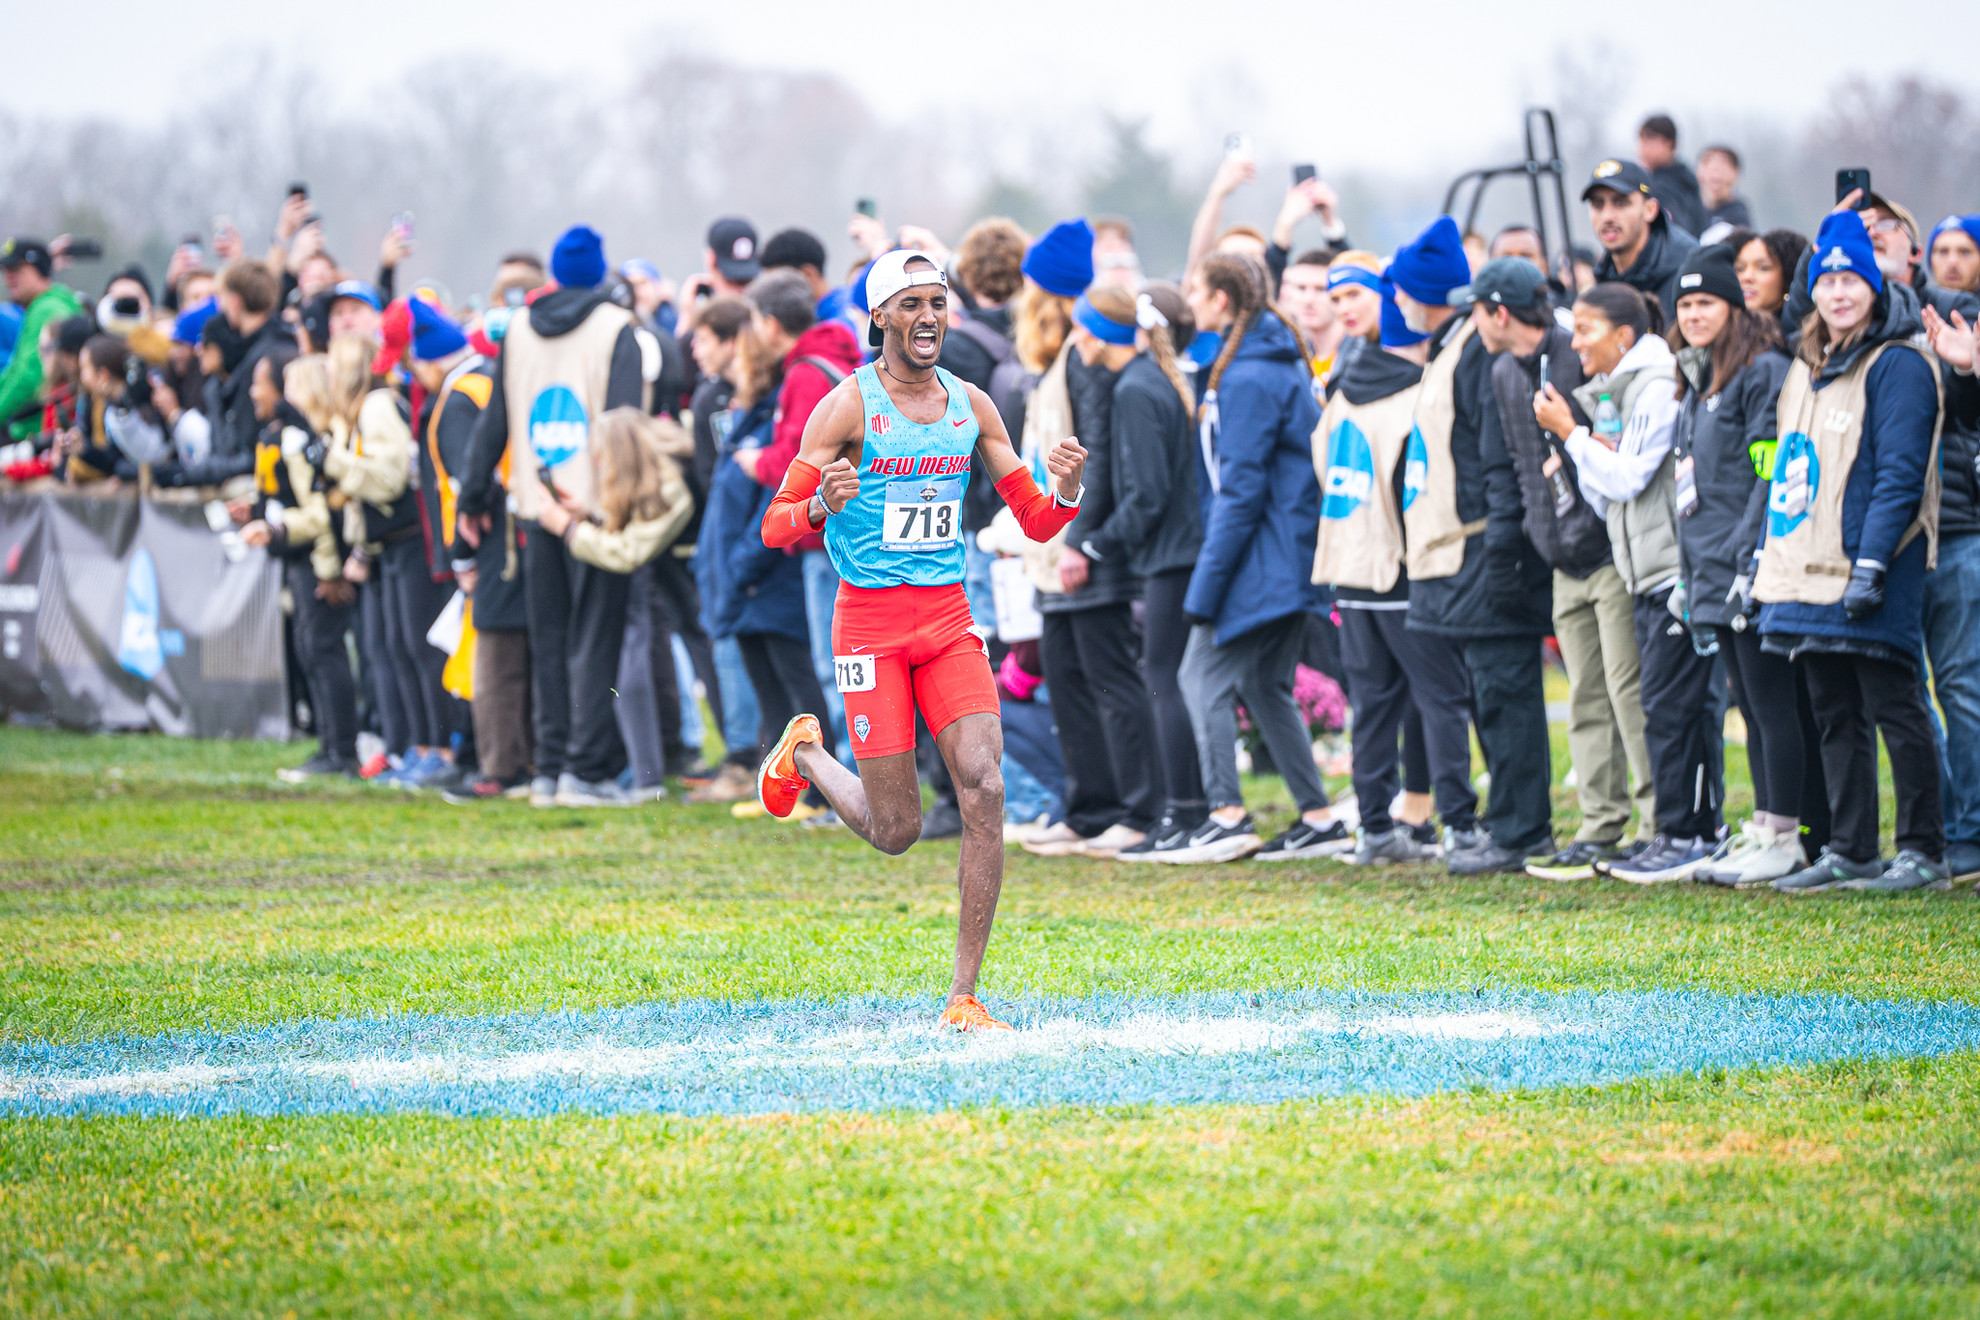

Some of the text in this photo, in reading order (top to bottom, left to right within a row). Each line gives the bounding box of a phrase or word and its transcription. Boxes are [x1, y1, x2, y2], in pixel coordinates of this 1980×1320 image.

[869, 456, 916, 476] NEW
[898, 504, 952, 539] 713
[837, 662, 864, 687] 713
